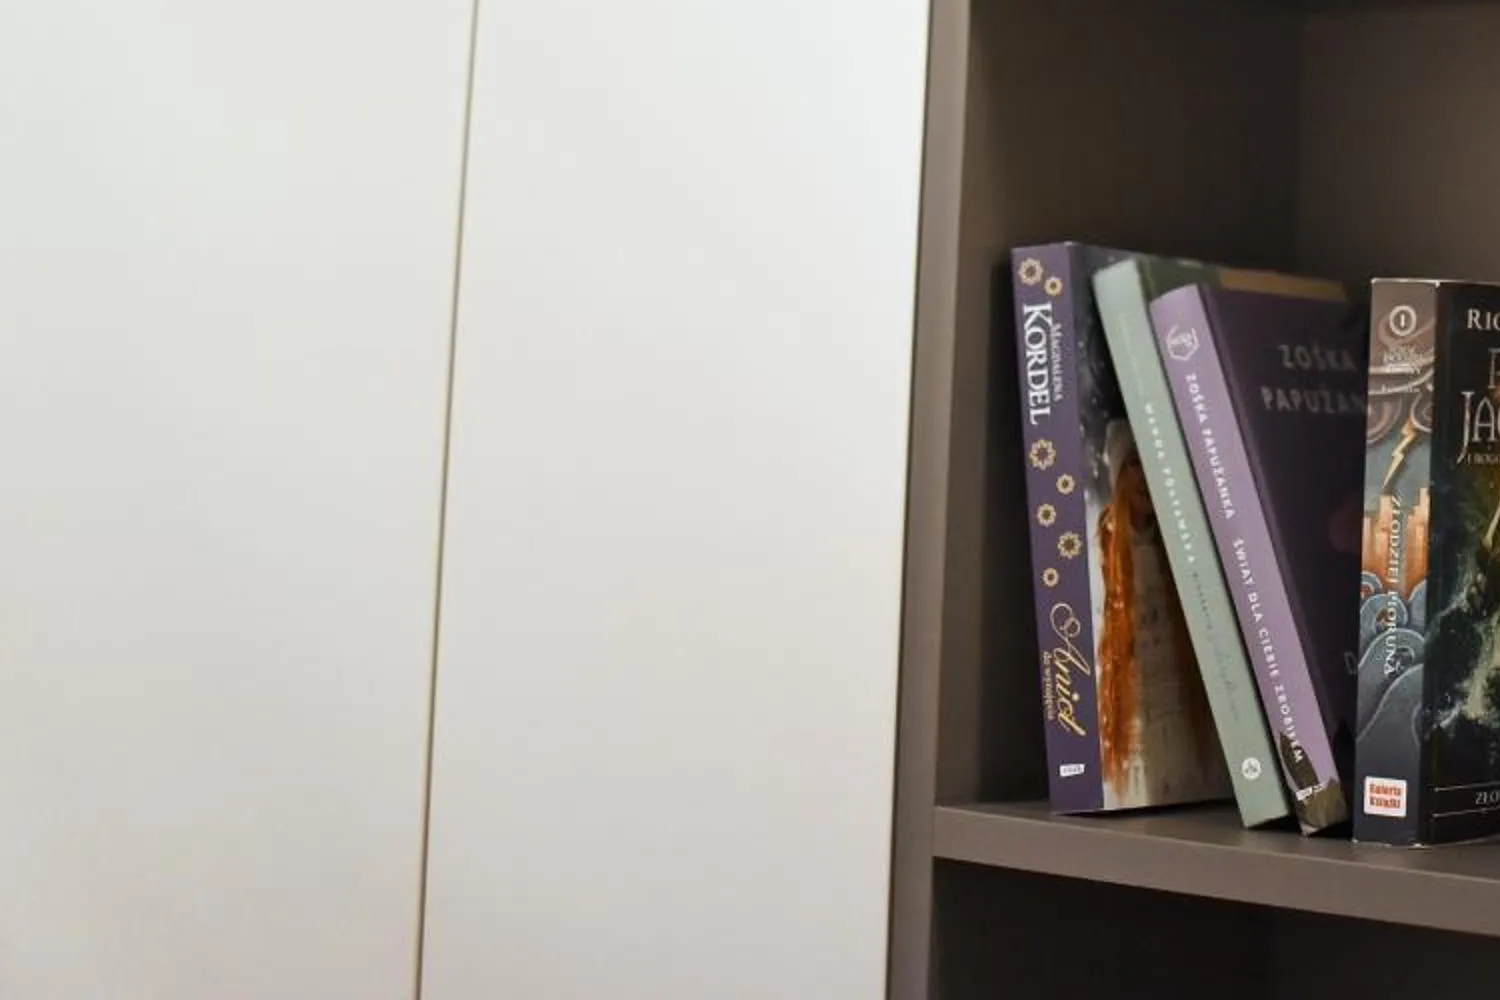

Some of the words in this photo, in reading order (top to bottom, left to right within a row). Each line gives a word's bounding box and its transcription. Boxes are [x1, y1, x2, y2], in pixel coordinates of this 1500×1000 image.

[1022, 302, 1053, 425] KORDEL
[1184, 372, 1207, 424] ZOŚKA
[1248, 591, 1265, 623] DLA
[1258, 627, 1281, 677] CIEBIE
